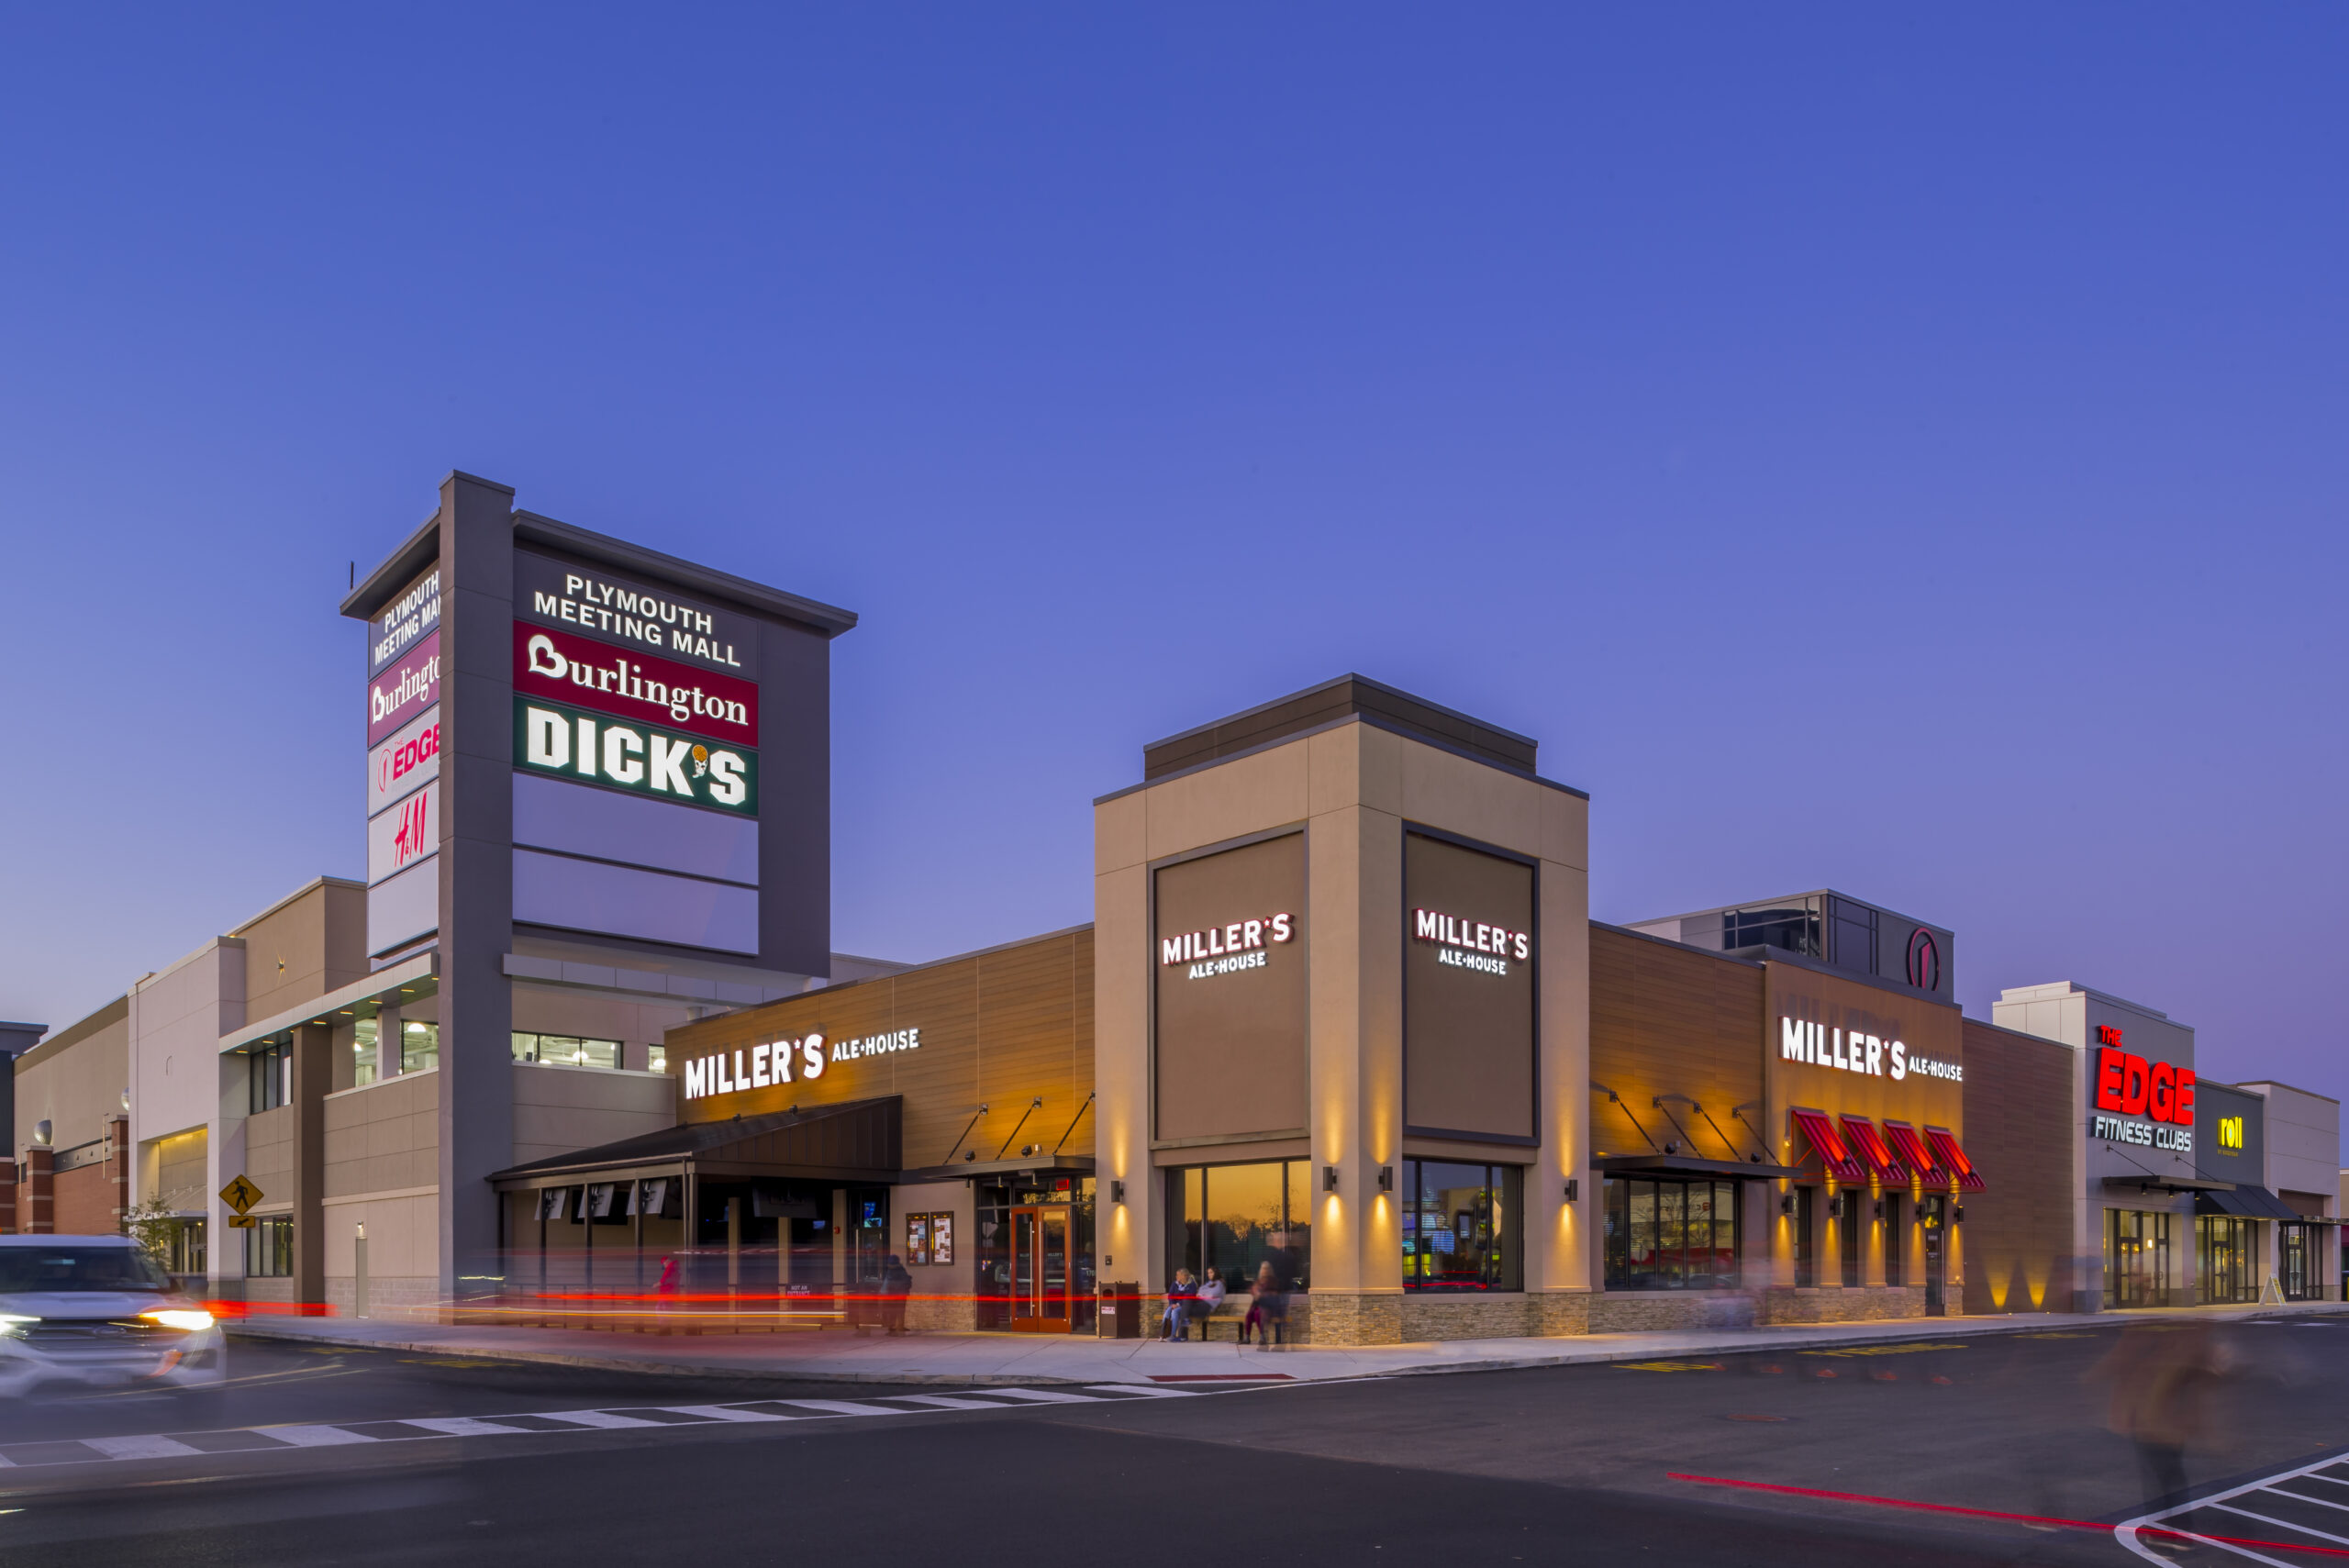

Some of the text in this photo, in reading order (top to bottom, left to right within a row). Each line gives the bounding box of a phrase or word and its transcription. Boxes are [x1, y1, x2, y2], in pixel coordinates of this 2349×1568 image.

[384, 571, 440, 633] PLYMOUTH
[534, 591, 741, 667] MEETING MALL
[565, 573, 712, 635] PLYMOUTH
[374, 615, 419, 666] MEETING
[528, 633, 749, 726] Burlington
[392, 722, 440, 781] EDGE
[527, 706, 746, 806] DICK'S
[394, 790, 428, 868] H&M
[1163, 912, 1292, 965] MILLER'S
[1414, 908, 1528, 960] MILLER'S
[685, 1033, 826, 1100] MILLER'S
[1781, 1016, 1906, 1081] MILLER'S
[2100, 1025, 2122, 1047] THE
[2097, 1046, 2196, 1126] EDGE
[2095, 1116, 2192, 1152] FITNESS CLUBS
[2220, 1116, 2243, 1149] roll
